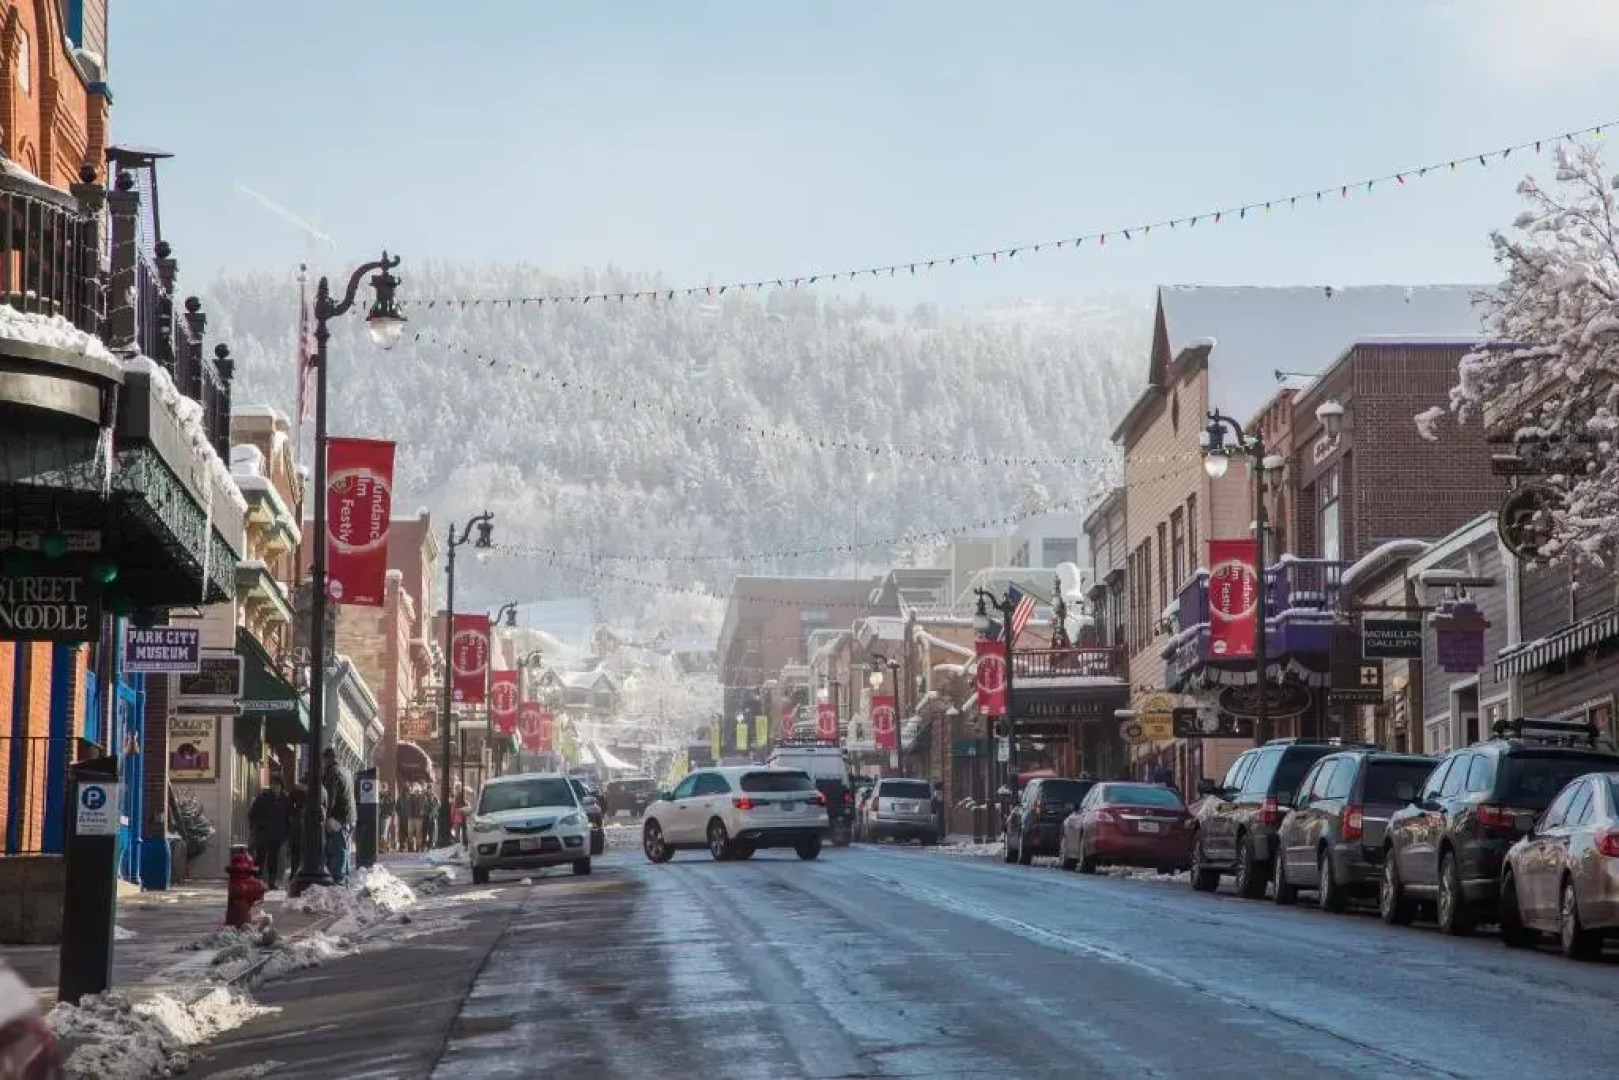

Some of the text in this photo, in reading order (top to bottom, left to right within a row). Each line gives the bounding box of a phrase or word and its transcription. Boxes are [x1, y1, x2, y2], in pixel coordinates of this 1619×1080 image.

[338, 498, 354, 553] Festivl
[370, 478, 384, 545] undanc
[129, 631, 197, 644] PARK CITY
[136, 647, 189, 660] MUSEUM
